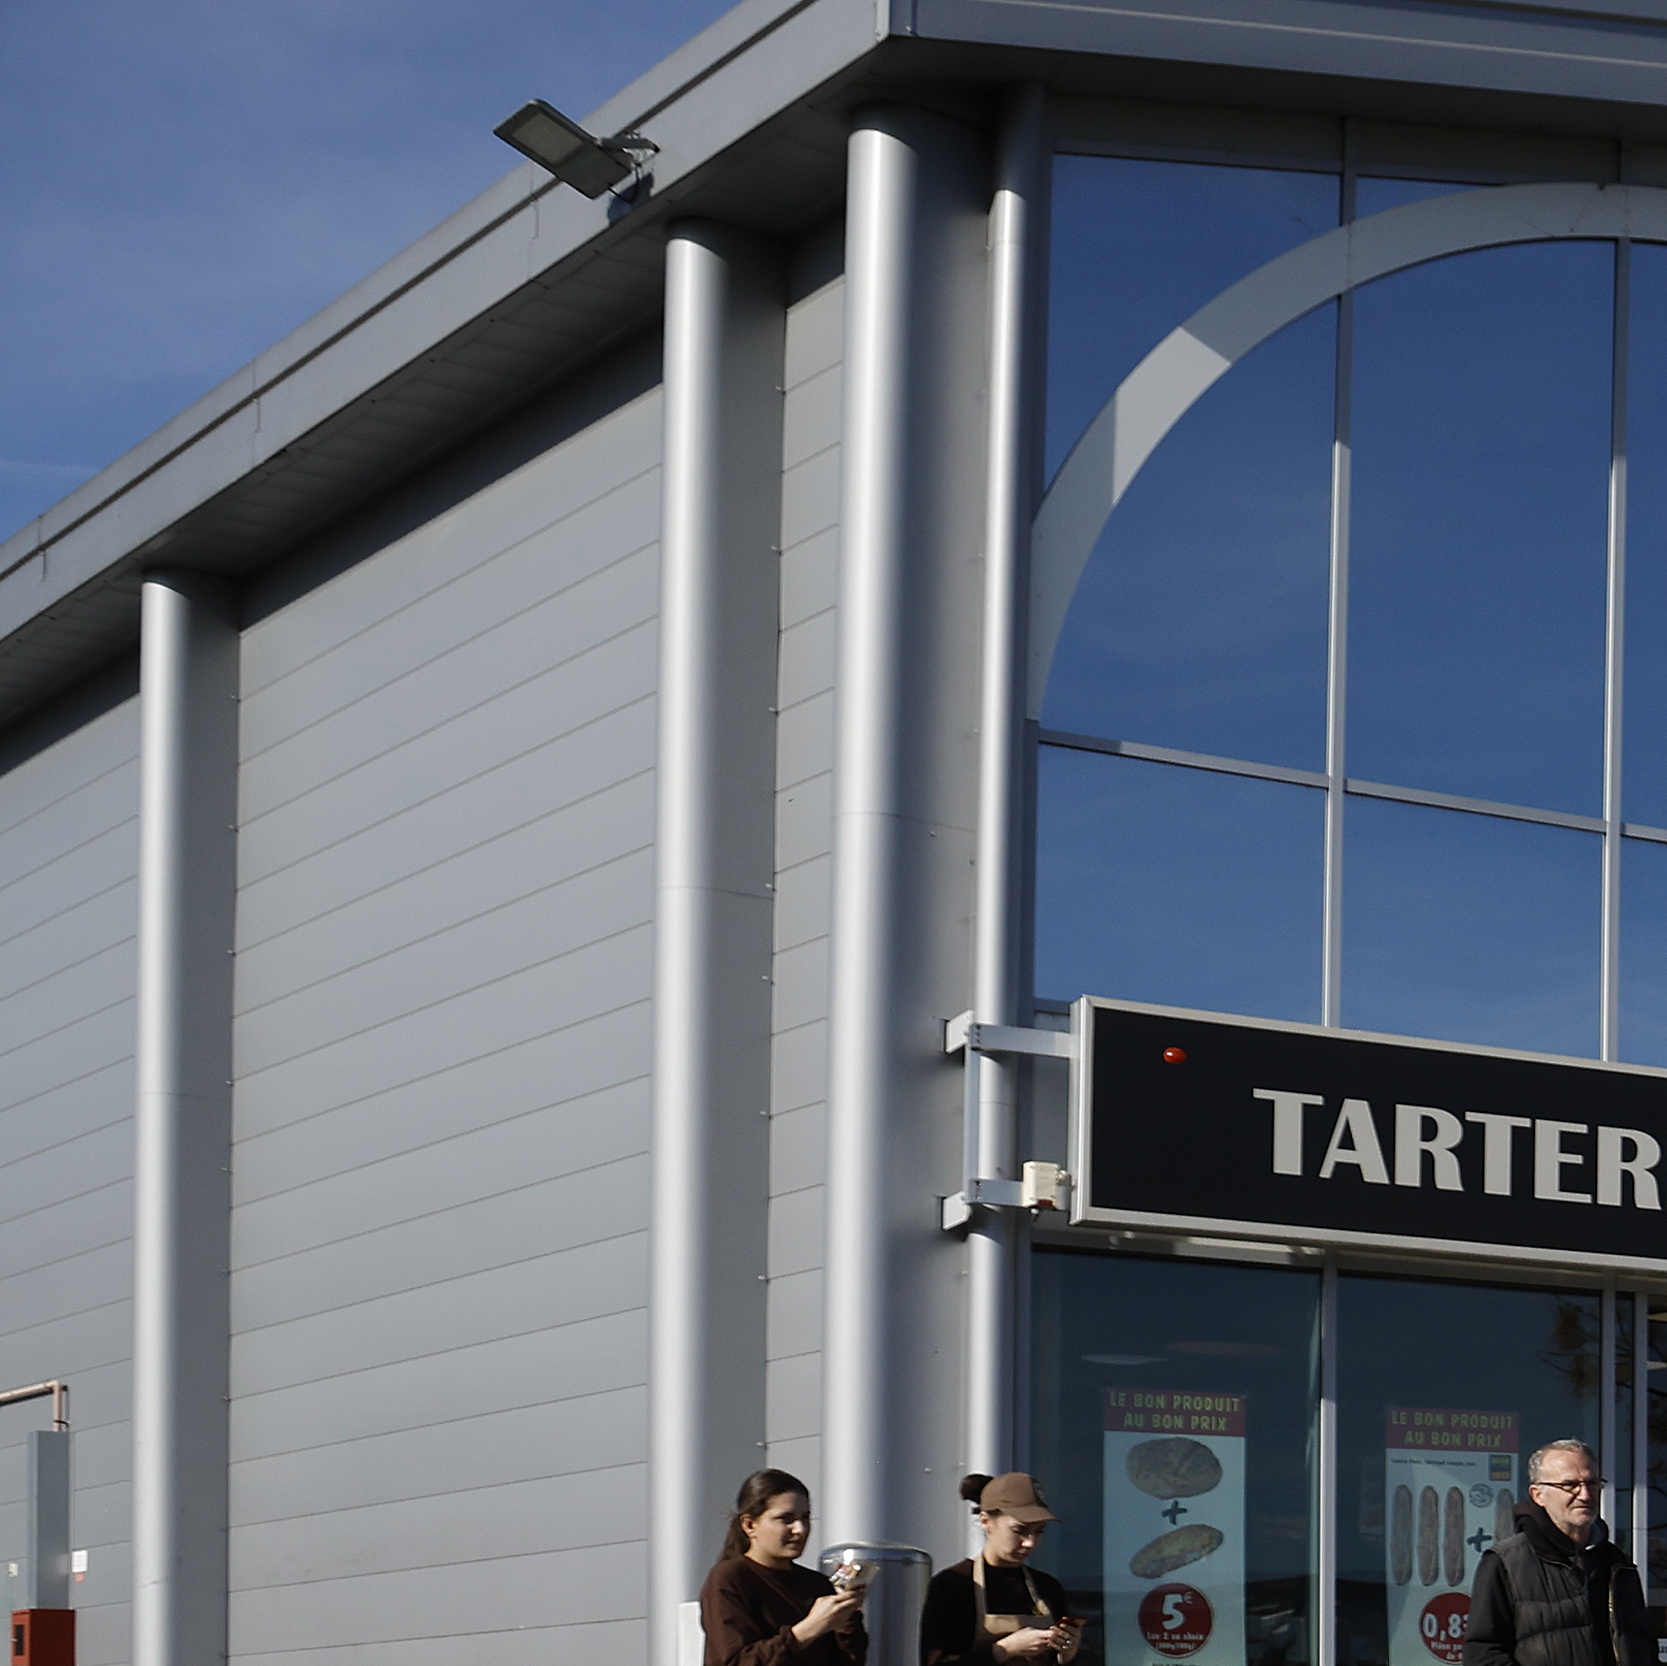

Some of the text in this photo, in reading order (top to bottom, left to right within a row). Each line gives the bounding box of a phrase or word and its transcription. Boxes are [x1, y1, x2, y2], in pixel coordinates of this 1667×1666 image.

[1110, 1392, 1240, 1412] LE BON PRODUIT
[1123, 1412, 1227, 1431] AU BON PRIX
[1391, 1410, 1513, 1430] LE BON PRODUIT
[1404, 1430, 1501, 1448] AU BON PRIX
